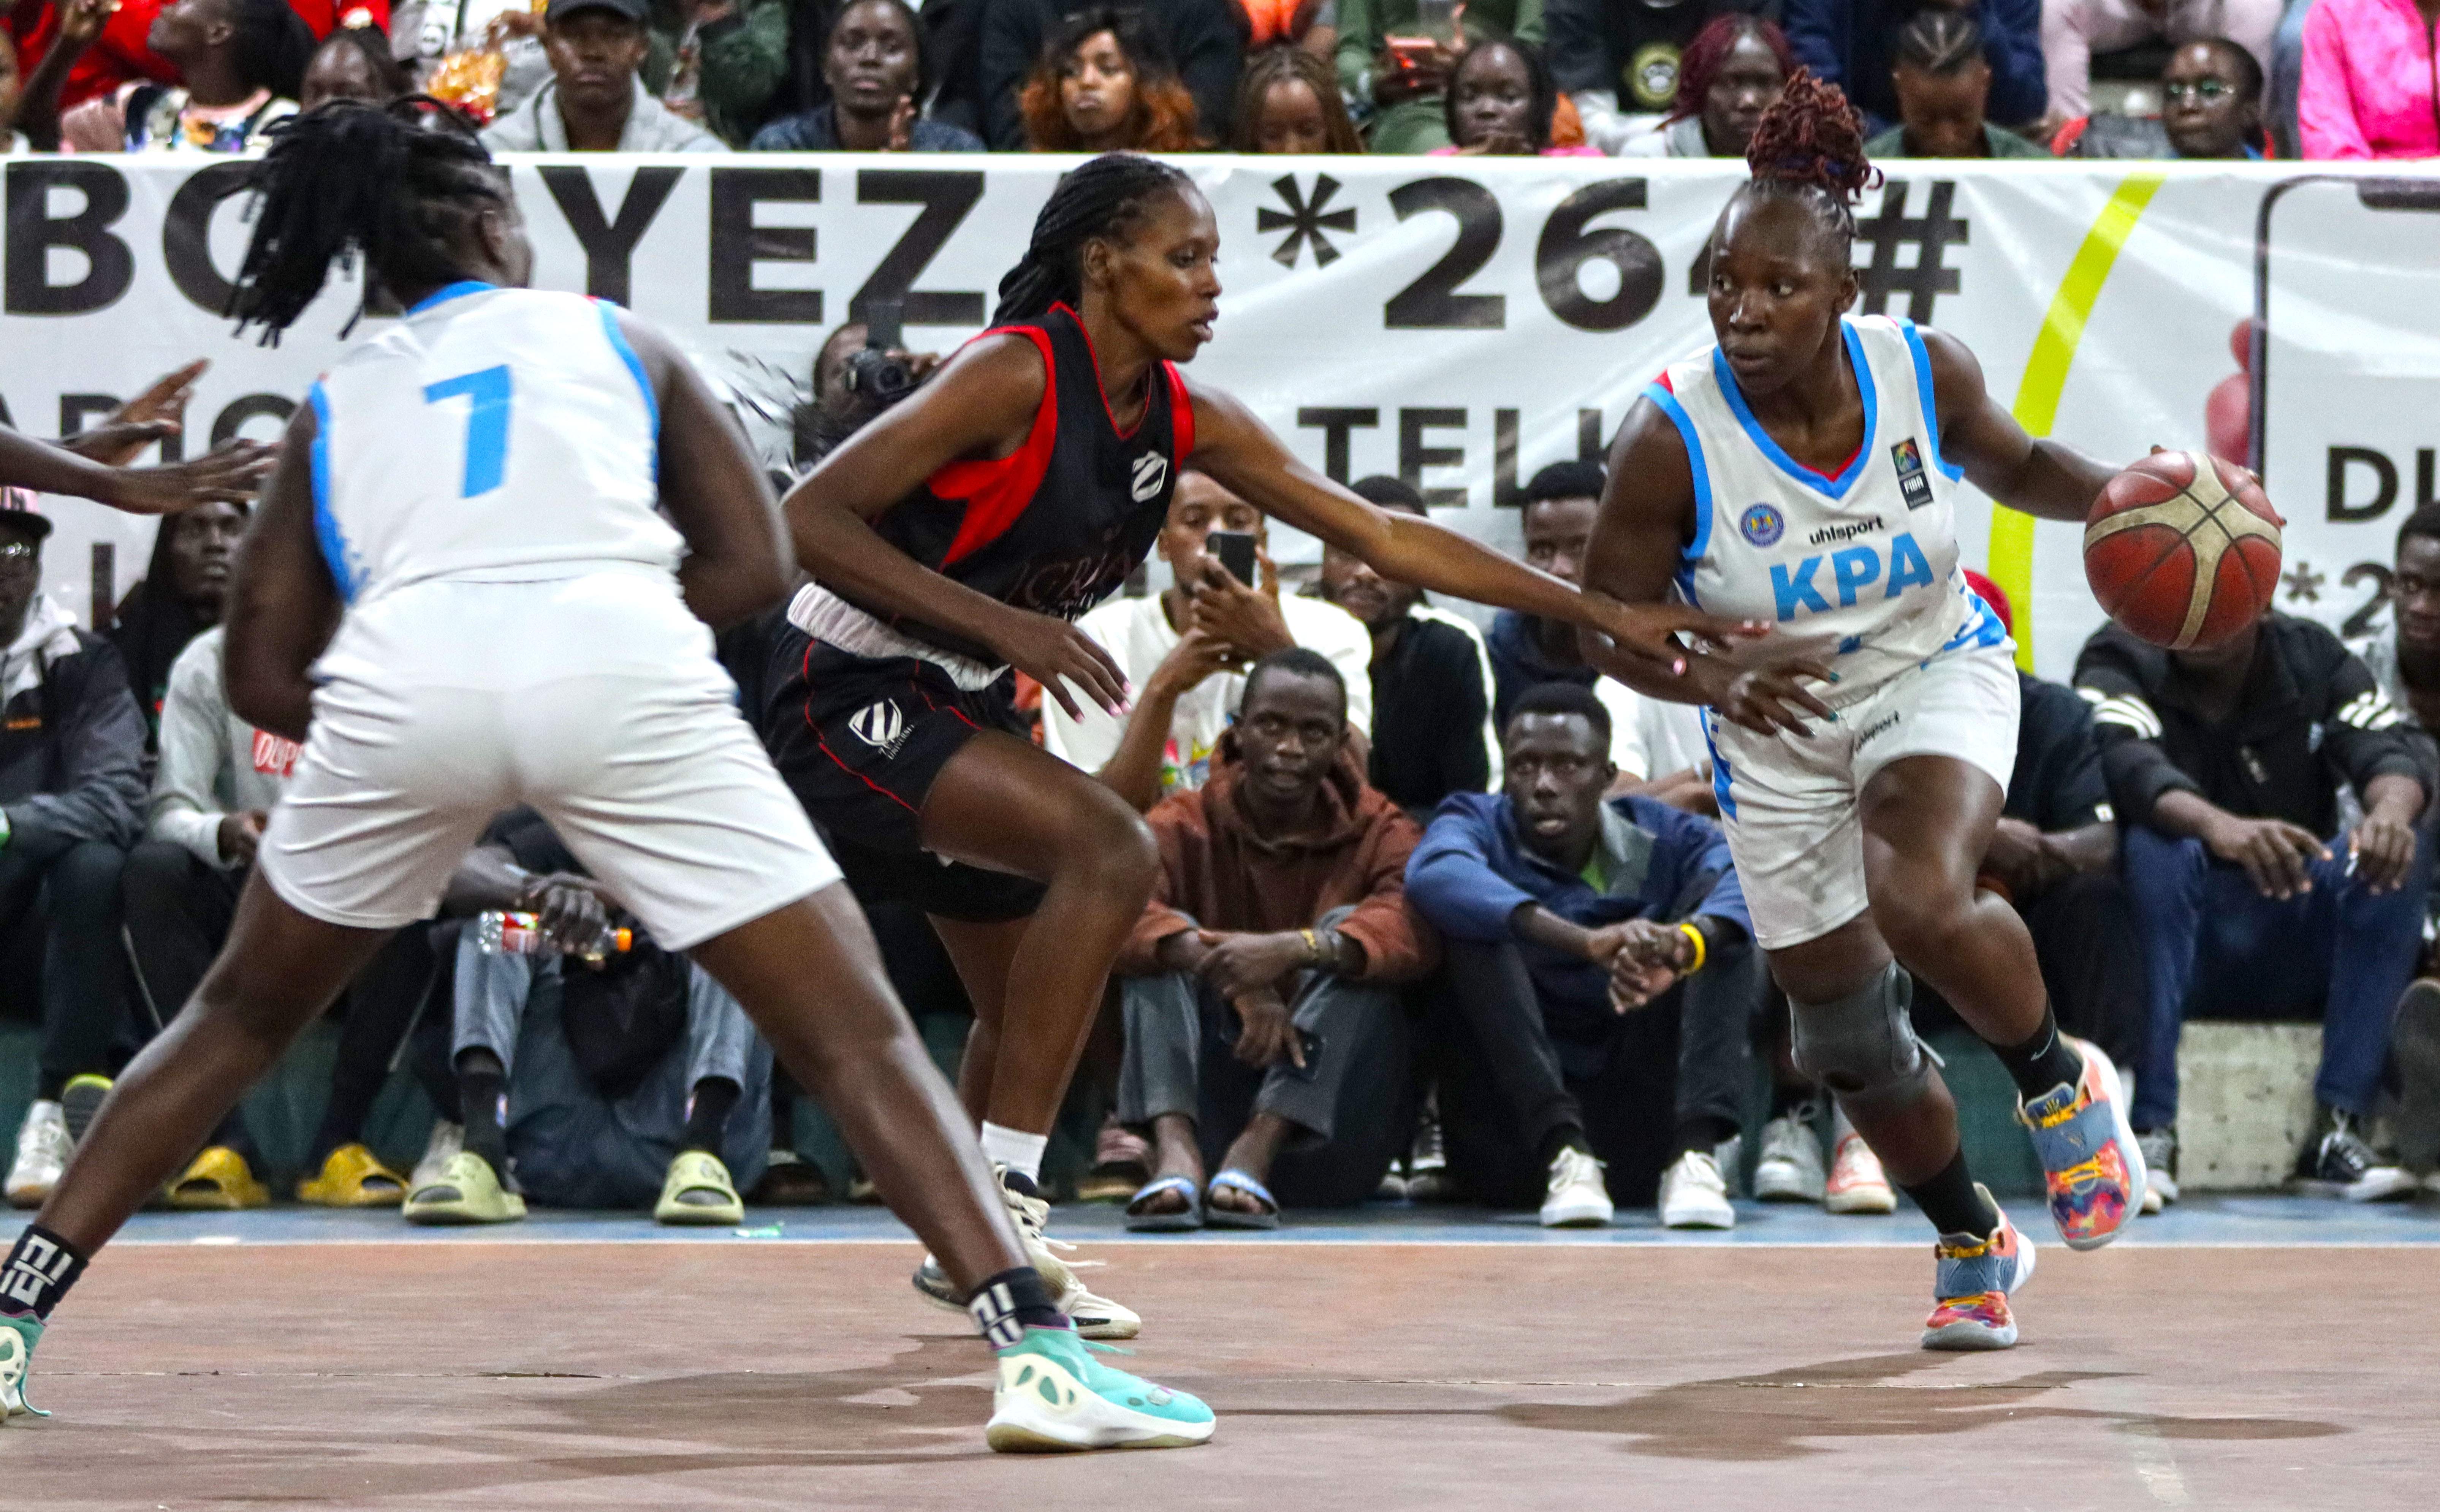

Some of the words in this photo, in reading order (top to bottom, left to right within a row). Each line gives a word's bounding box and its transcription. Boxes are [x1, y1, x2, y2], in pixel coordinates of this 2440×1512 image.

[1256, 173, 1970, 333] 26#
[421, 363, 511, 498] 7
[1769, 532, 1934, 622] KPA
[1809, 515, 1884, 546] uhlsport
